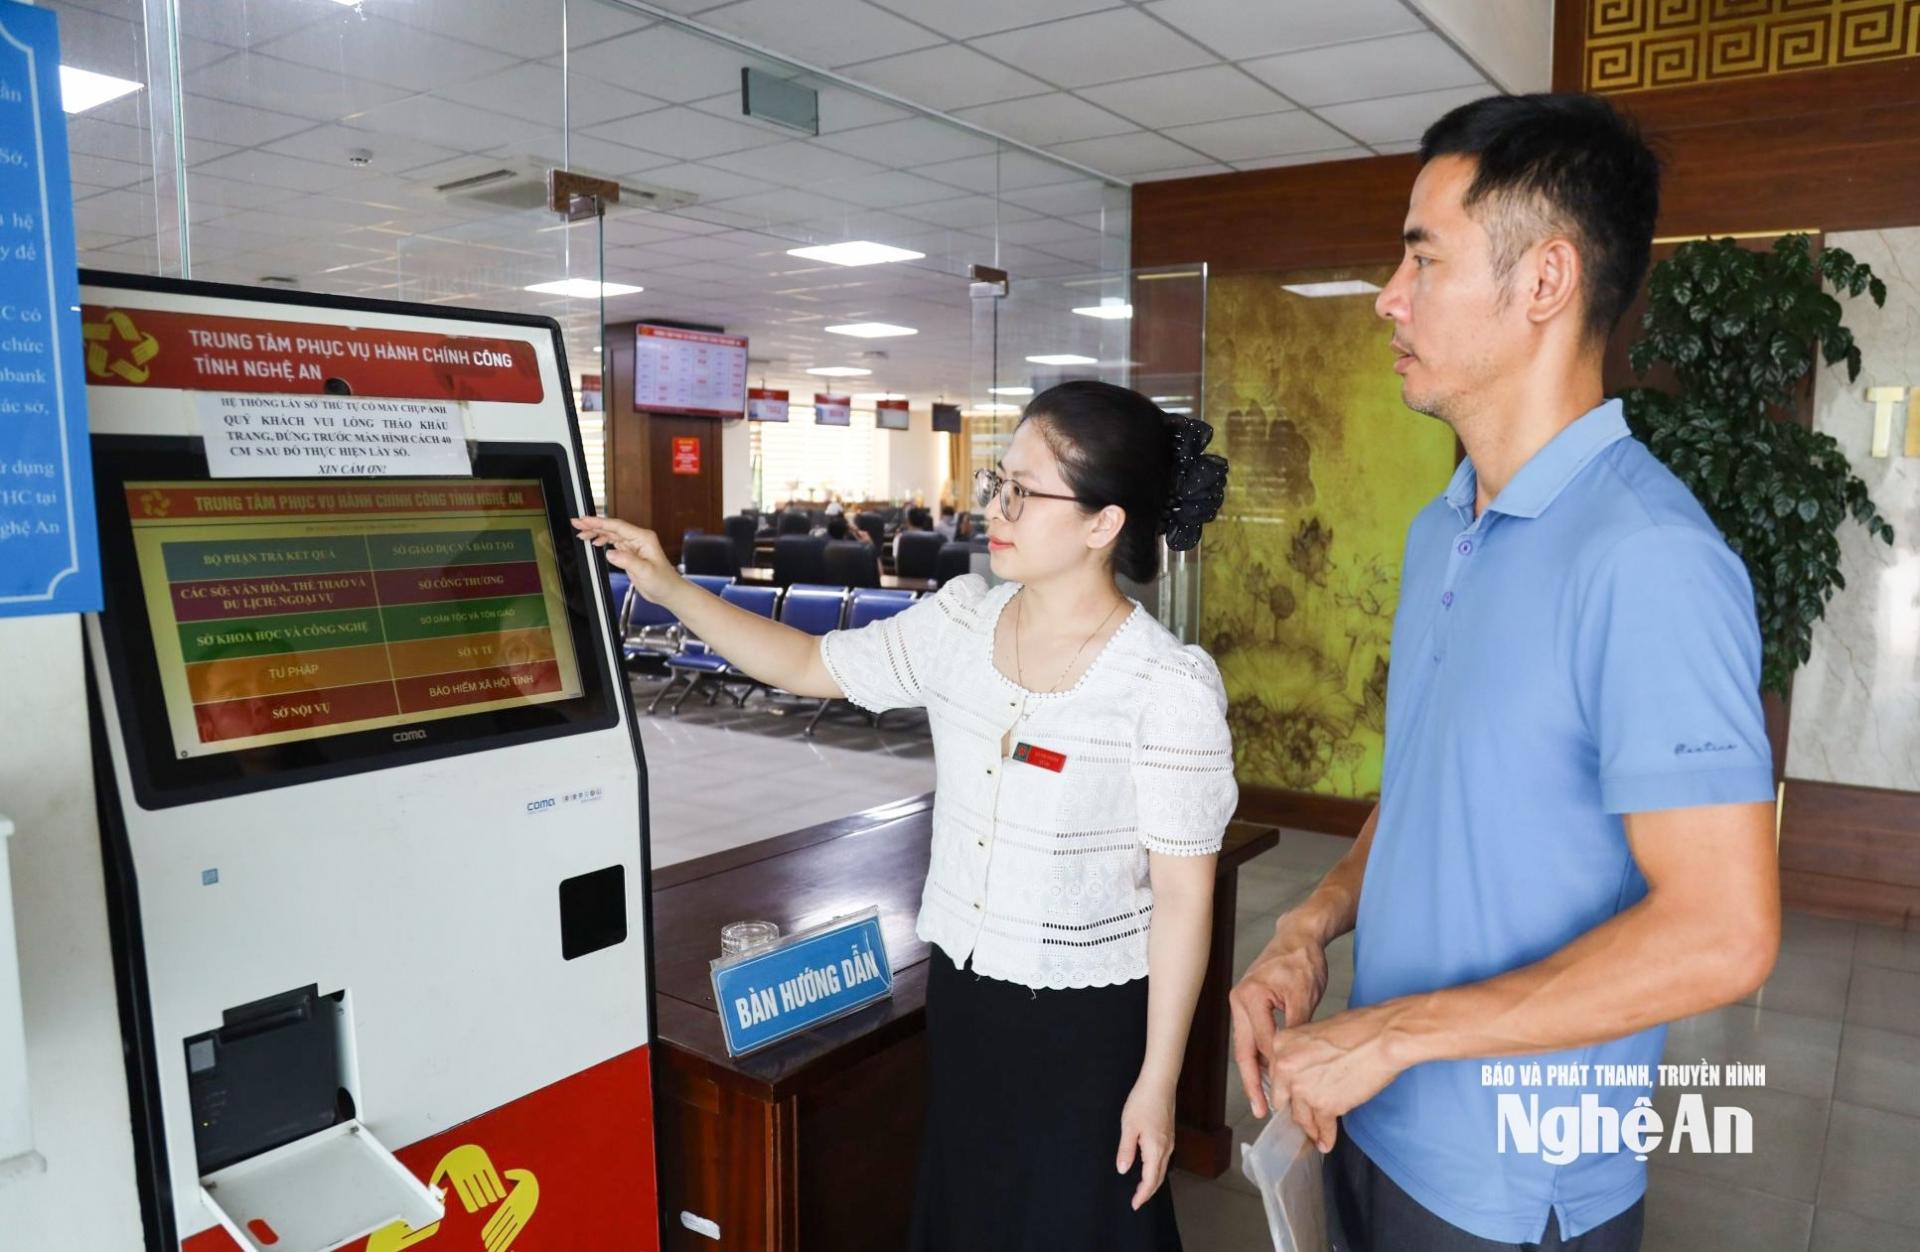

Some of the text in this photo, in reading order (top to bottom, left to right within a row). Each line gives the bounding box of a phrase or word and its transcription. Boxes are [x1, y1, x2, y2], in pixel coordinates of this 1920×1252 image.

[2, 336, 44, 354] chức
[188, 329, 513, 369] TRUNG TÂM PHỤC VỤ HÀNH CHÍNH CÔNG
[193, 353, 323, 382] TỈNH NGHỆ AN
[401, 404, 428, 415] CHỤP
[223, 413, 252, 427] QUÝ
[261, 415, 306, 427] KHÁCH
[314, 417, 335, 428] VUI
[343, 416, 375, 429] LÒNG
[354, 432, 381, 444] MÀN
[381, 433, 410, 444] HÌNH
[411, 434, 441, 445] CÁCH
[441, 436, 453, 445] 40
[229, 446, 252, 457] CM
[255, 447, 282, 457] SAU
[283, 445, 301, 457] ĐÓ
[302, 446, 338, 458] THỰC
[339, 447, 368, 459] HIỆN
[12, 459, 55, 479] dụng
[318, 464, 340, 475] XIN
[0, 489, 33, 506] HC
[194, 495, 243, 512] TRUNG
[246, 493, 277, 510] TÂM
[279, 494, 315, 511] PHỤC
[318, 494, 337, 511] VỤ
[415, 491, 447, 507] CÔNG
[508, 492, 524, 505] AN
[35, 519, 60, 535] An
[180, 586, 208, 600] CÁC
[232, 583, 258, 597] VĂN
[318, 579, 349, 591] THAO
[350, 576, 367, 588] VÀ
[434, 575, 463, 589] CÔNG
[464, 574, 505, 588] THƯƠNG
[223, 599, 241, 611] DU
[279, 593, 317, 607] NGOẠI
[318, 592, 335, 605] VỤ
[216, 631, 253, 645] KHOA
[255, 629, 282, 643] HỌC
[283, 625, 302, 639] VÀ
[302, 623, 337, 638] CÔNG
[338, 619, 369, 634] NGHỆ
[287, 663, 320, 677] PHÁP
[479, 676, 494, 691] XÃ
[494, 675, 511, 689] HỘI
[290, 704, 313, 718] NỘI
[314, 701, 331, 715] VỤ
[735, 944, 880, 1031] BÀN HƯỚNG DẪN
